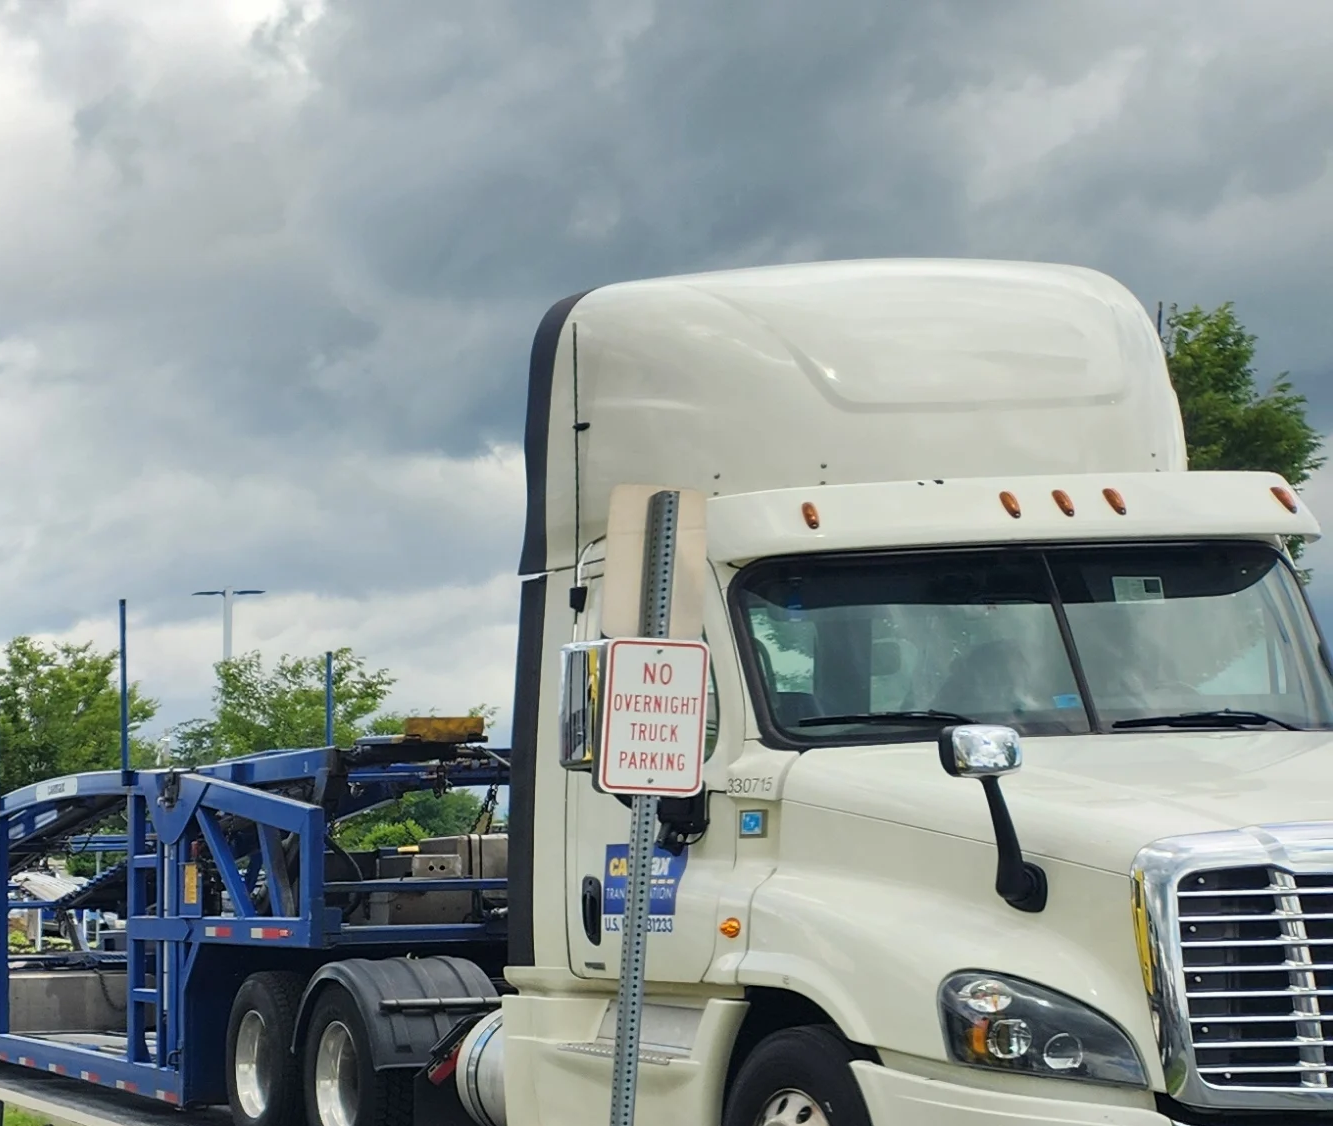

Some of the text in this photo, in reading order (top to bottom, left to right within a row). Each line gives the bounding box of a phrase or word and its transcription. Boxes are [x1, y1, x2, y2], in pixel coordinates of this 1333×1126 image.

[643, 662, 673, 685] NO
[613, 694, 699, 715] OVERNIGHT
[630, 723, 679, 743] TRUCK
[618, 751, 686, 771] PARKING
[727, 776, 773, 794] 330715
